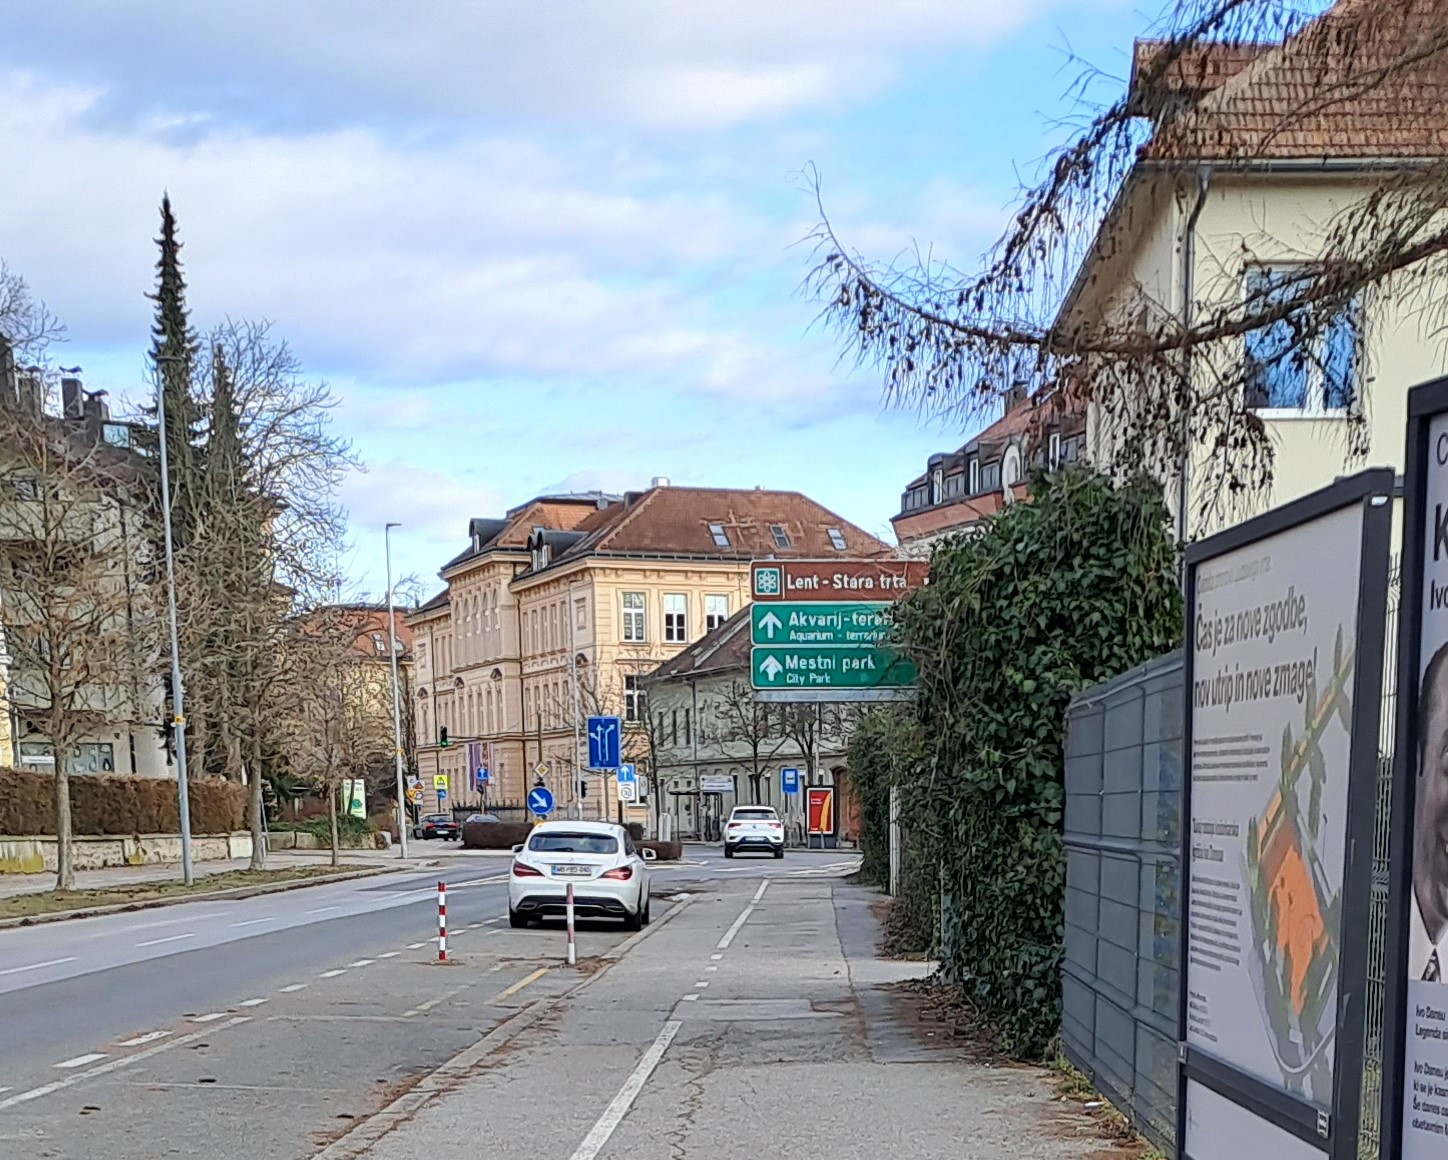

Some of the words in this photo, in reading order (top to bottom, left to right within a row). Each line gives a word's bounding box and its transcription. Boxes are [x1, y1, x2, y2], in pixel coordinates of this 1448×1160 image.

[787, 573, 819, 589] Lent
[833, 574, 874, 589] Stara
[880, 573, 907, 589] trta
[1195, 602, 1212, 652] Čas
[1212, 609, 1222, 657] je
[1224, 614, 1235, 645] za
[1236, 607, 1261, 641] nove
[1262, 585, 1308, 644] zgodbe,
[789, 630, 834, 642] Aquarium
[785, 654, 836, 670] Mestni
[842, 653, 876, 673] park
[786, 672, 805, 685] City
[809, 672, 831, 684] Park
[1194, 679, 1210, 708] nov
[1211, 664, 1233, 713] utrip
[1234, 662, 1244, 702] in
[1246, 667, 1271, 701] nove
